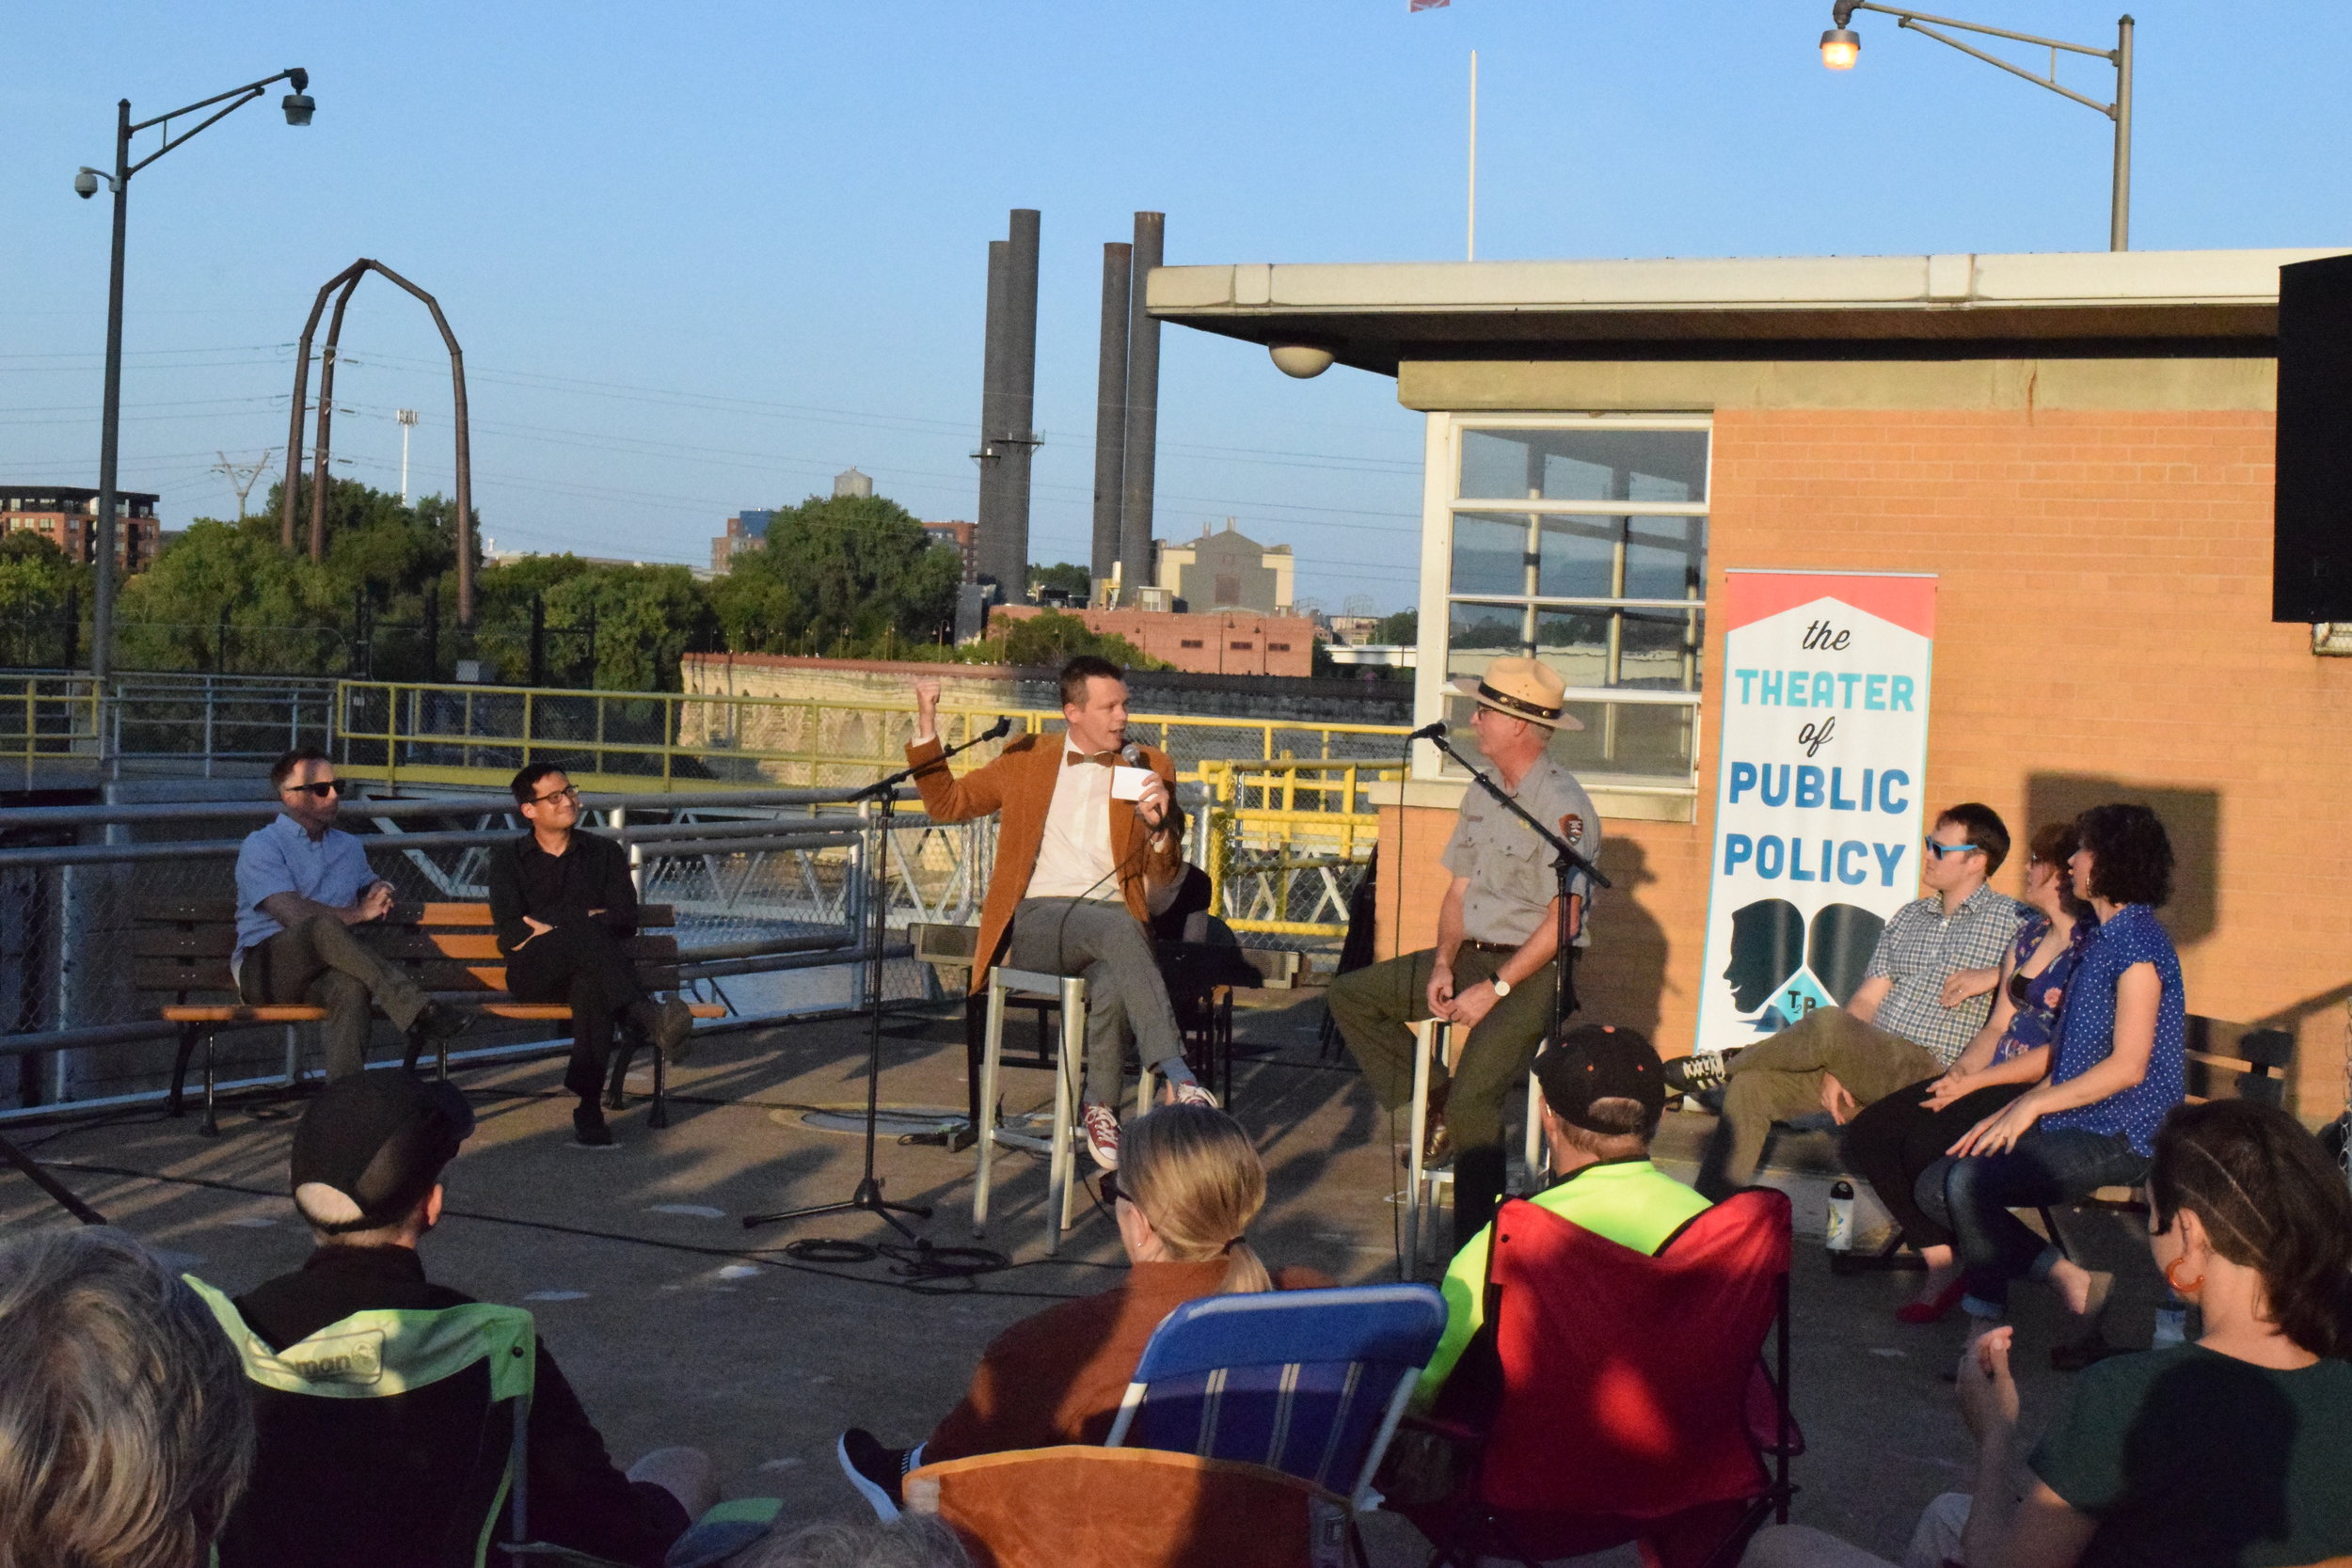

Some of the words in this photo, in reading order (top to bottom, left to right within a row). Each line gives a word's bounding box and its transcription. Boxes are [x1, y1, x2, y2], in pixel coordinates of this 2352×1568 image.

[1802, 620, 1851, 651] the
[1735, 669, 1914, 711] THEATER
[1798, 716, 1836, 758] of
[1729, 761, 1910, 815] PUBLIC
[1723, 833, 1906, 887] POLICY
